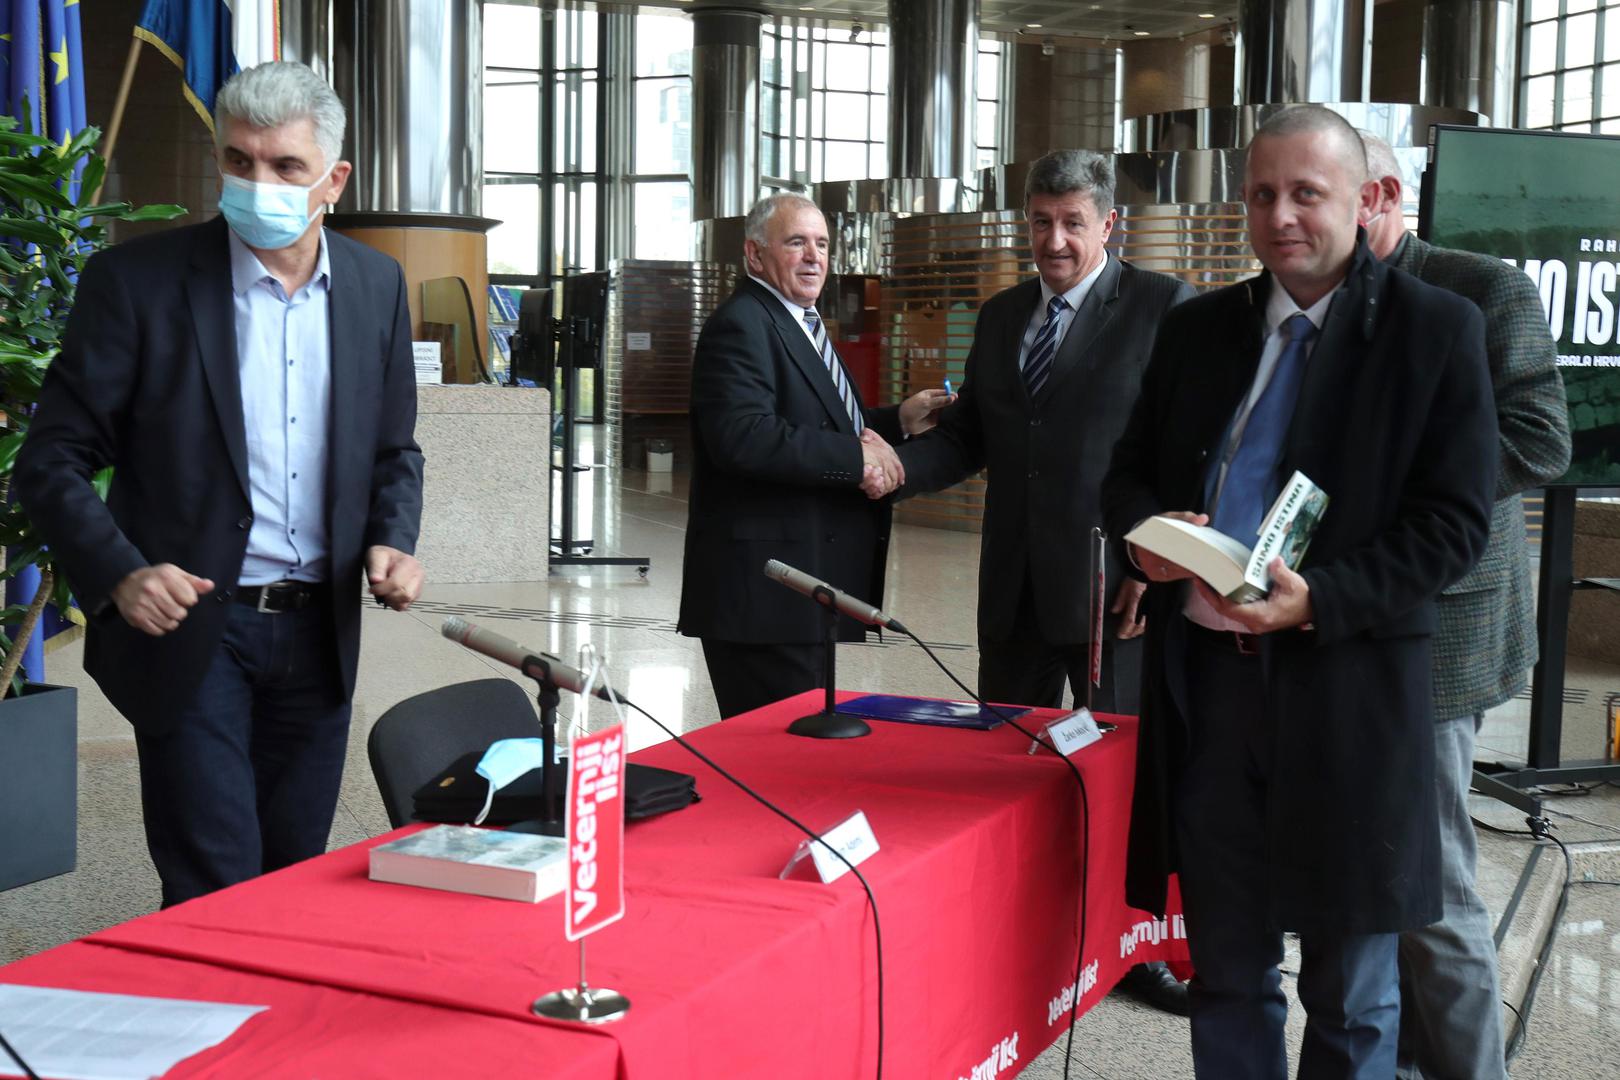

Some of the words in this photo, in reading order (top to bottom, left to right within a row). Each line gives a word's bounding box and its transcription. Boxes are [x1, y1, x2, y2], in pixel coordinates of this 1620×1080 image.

[1580, 238, 1620, 252] RAH
[1572, 261, 1620, 345] IS
[1251, 532, 1276, 578] SAMO
[1273, 483, 1303, 530] ISTINA
[595, 733, 621, 803] list
[1172, 913, 1187, 940] li
